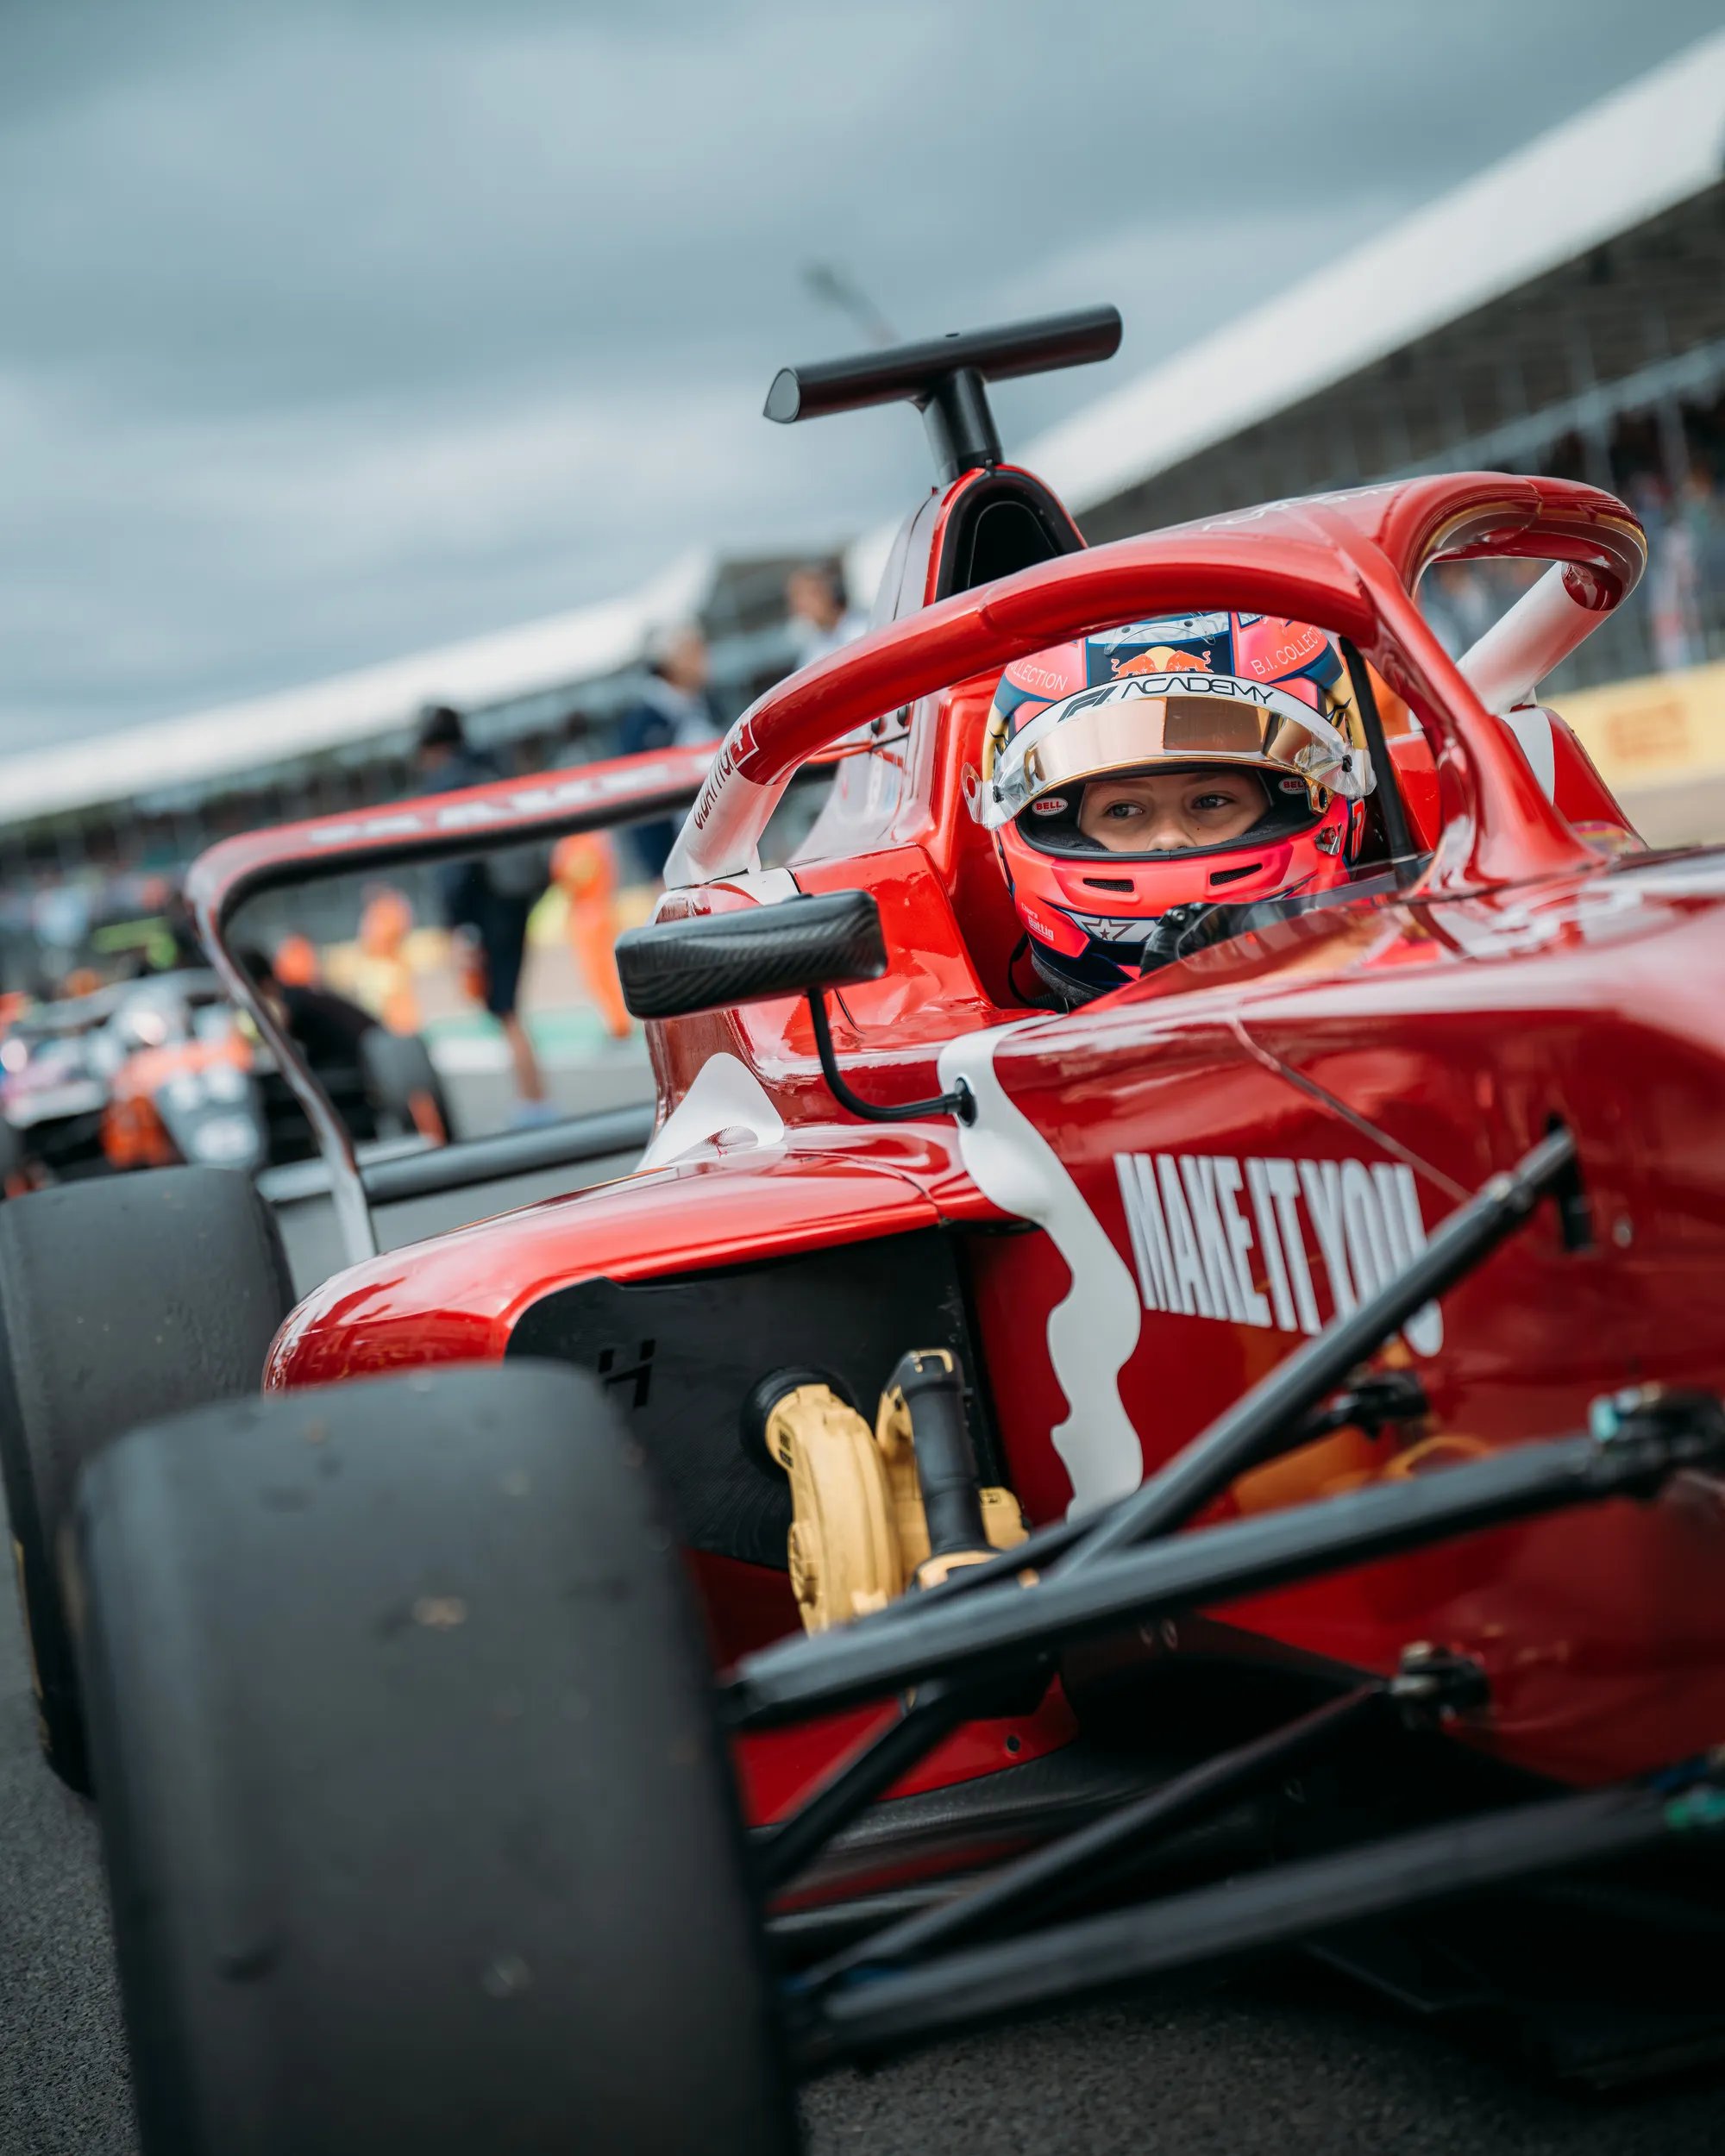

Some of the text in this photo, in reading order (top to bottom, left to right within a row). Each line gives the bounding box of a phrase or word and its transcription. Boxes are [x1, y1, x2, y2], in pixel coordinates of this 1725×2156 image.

[1121, 677, 1274, 705] ACADEMY
[1113, 1152, 1443, 1357] MAKE IT YOU
